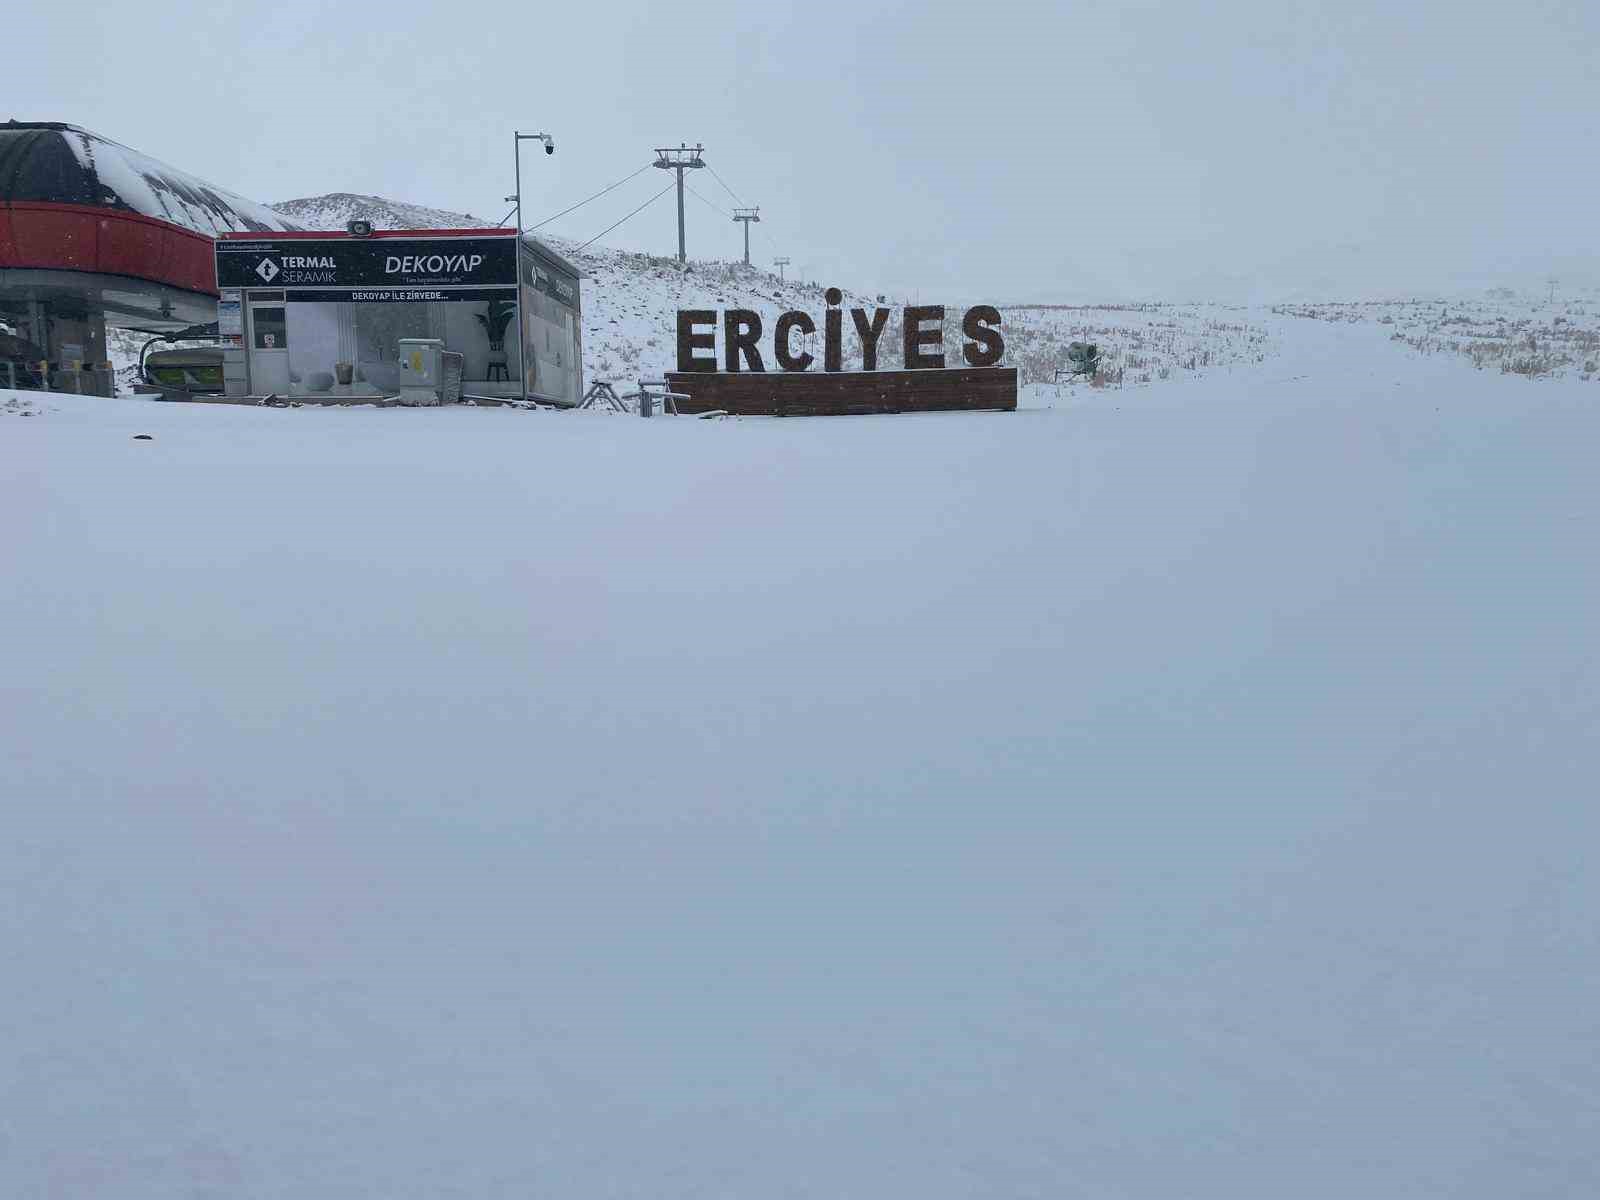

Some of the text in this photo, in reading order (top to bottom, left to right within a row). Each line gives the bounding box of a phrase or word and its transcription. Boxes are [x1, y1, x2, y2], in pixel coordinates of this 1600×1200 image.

[281, 256, 336, 268] TERMAL
[385, 254, 482, 274] DEKOYAP
[352, 291, 391, 300] DEKOYAP
[391, 290, 405, 300] İLE
[676, 287, 1005, 373] ERCİYES
